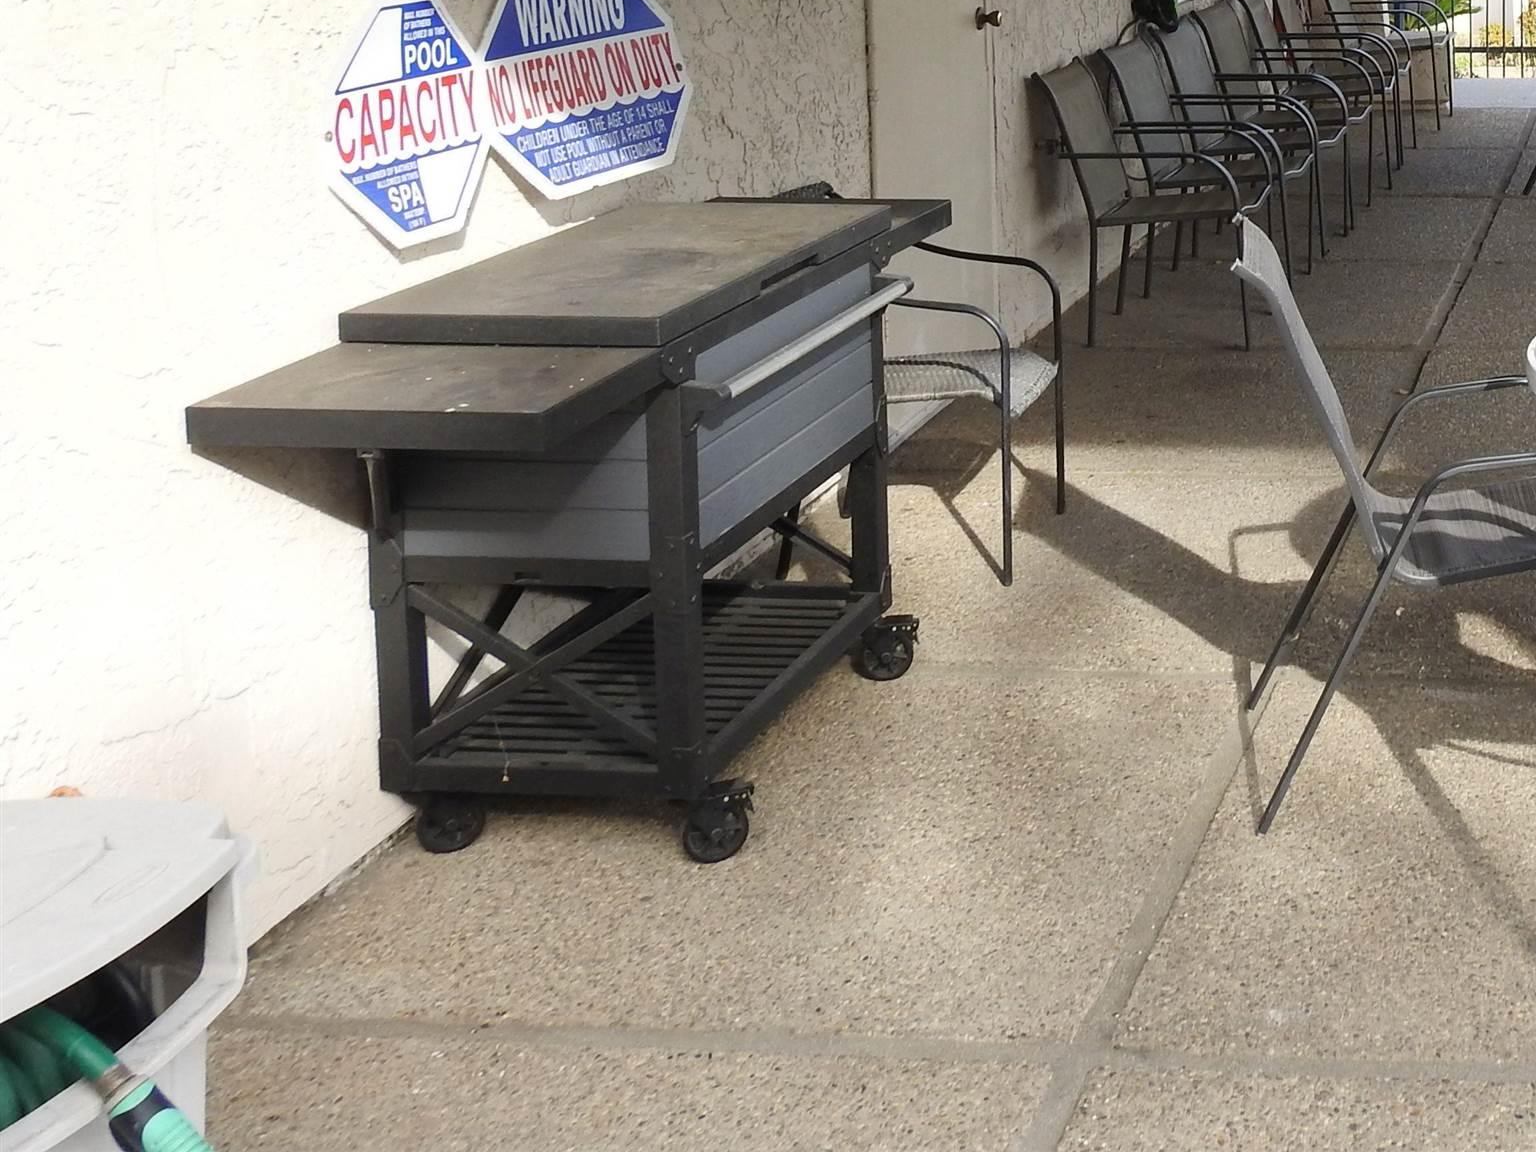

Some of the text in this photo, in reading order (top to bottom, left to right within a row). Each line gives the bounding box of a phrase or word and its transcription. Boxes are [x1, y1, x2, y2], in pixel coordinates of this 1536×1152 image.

[404, 37, 459, 74] POOL
[486, 32, 681, 128] NO LIFEGUARD ON DUTY
[336, 70, 478, 164] CAPACITY
[516, 99, 676, 153] CHILDREN UNDER THE AGE OF 14 SHALL
[534, 117, 668, 168] NOT USE POOL WITHOUT A PARENT OR
[549, 161, 574, 183] ADULT
[572, 150, 611, 178] GUARDIAN
[620, 137, 666, 163] ATTENDANCE
[388, 181, 425, 214] SPA
